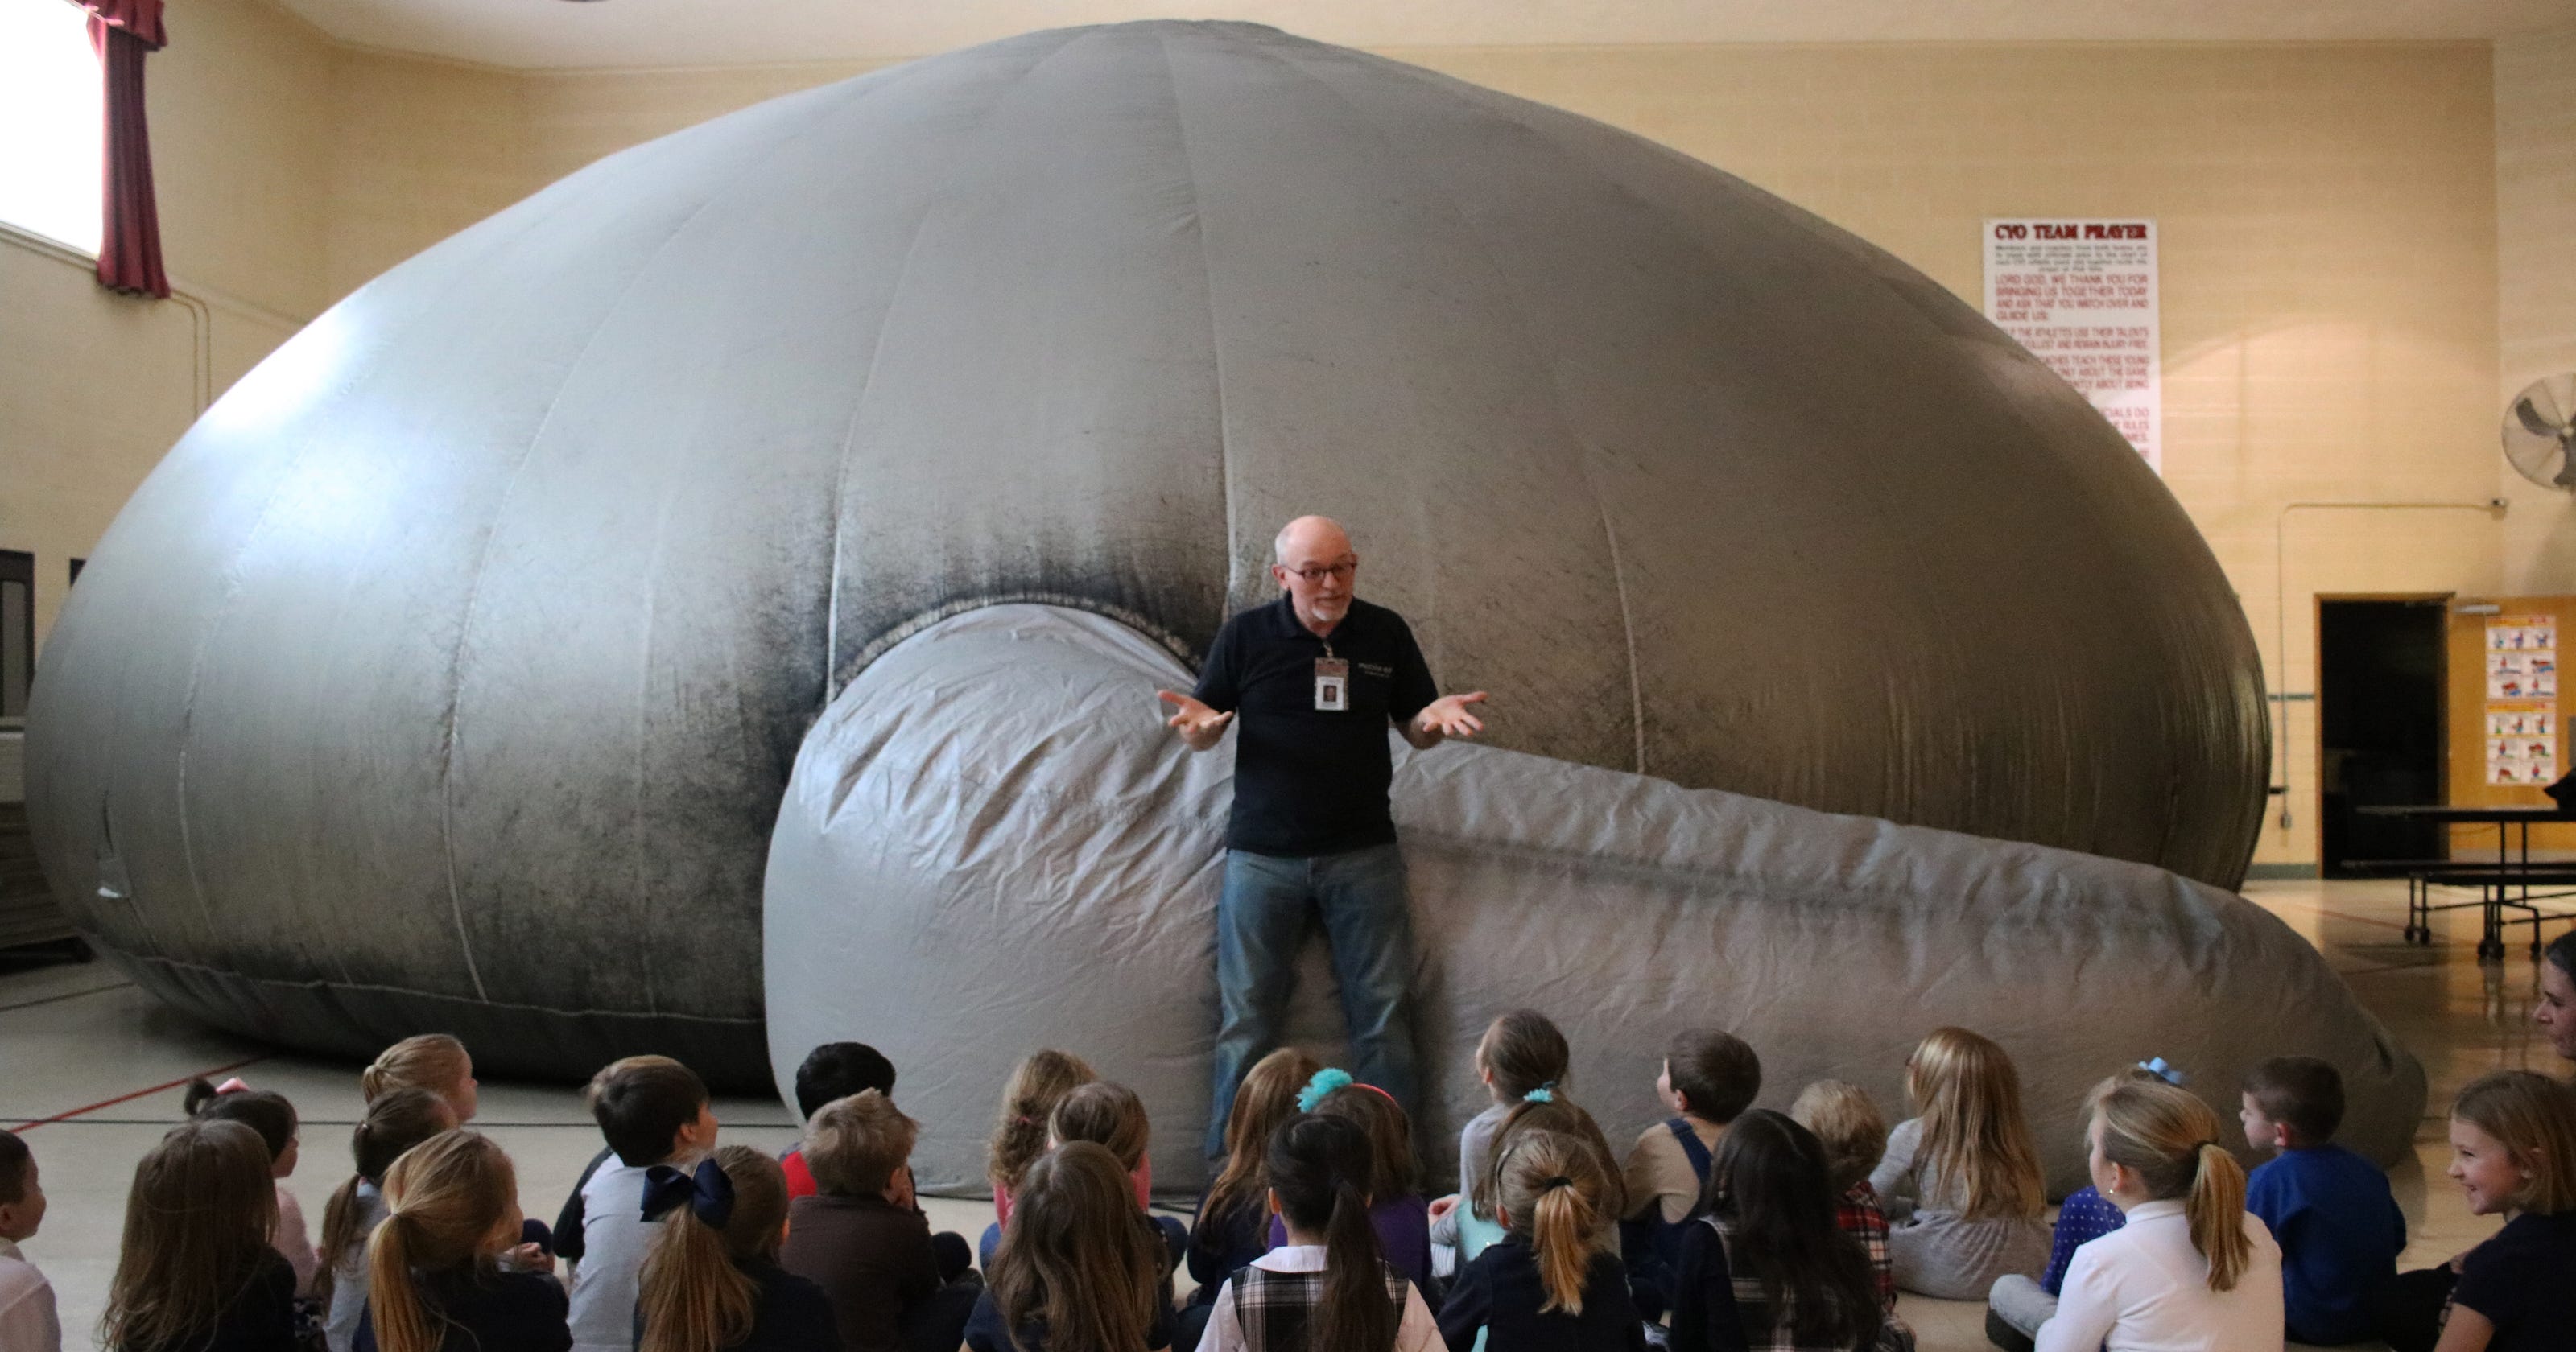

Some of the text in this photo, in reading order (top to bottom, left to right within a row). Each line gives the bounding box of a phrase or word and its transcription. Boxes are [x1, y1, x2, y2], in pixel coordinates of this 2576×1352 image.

[1995, 225, 2147, 240] CYO TEAM PRAYER
[2070, 274, 2102, 284] THANK
[2107, 274, 2124, 284] YOU
[2128, 274, 2147, 284] FOR
[1996, 286, 2041, 296] BRINGING
[2062, 286, 2113, 296] TOGETHER
[2035, 299, 2054, 308] THAT
[1996, 311, 2027, 321] GUIDE
